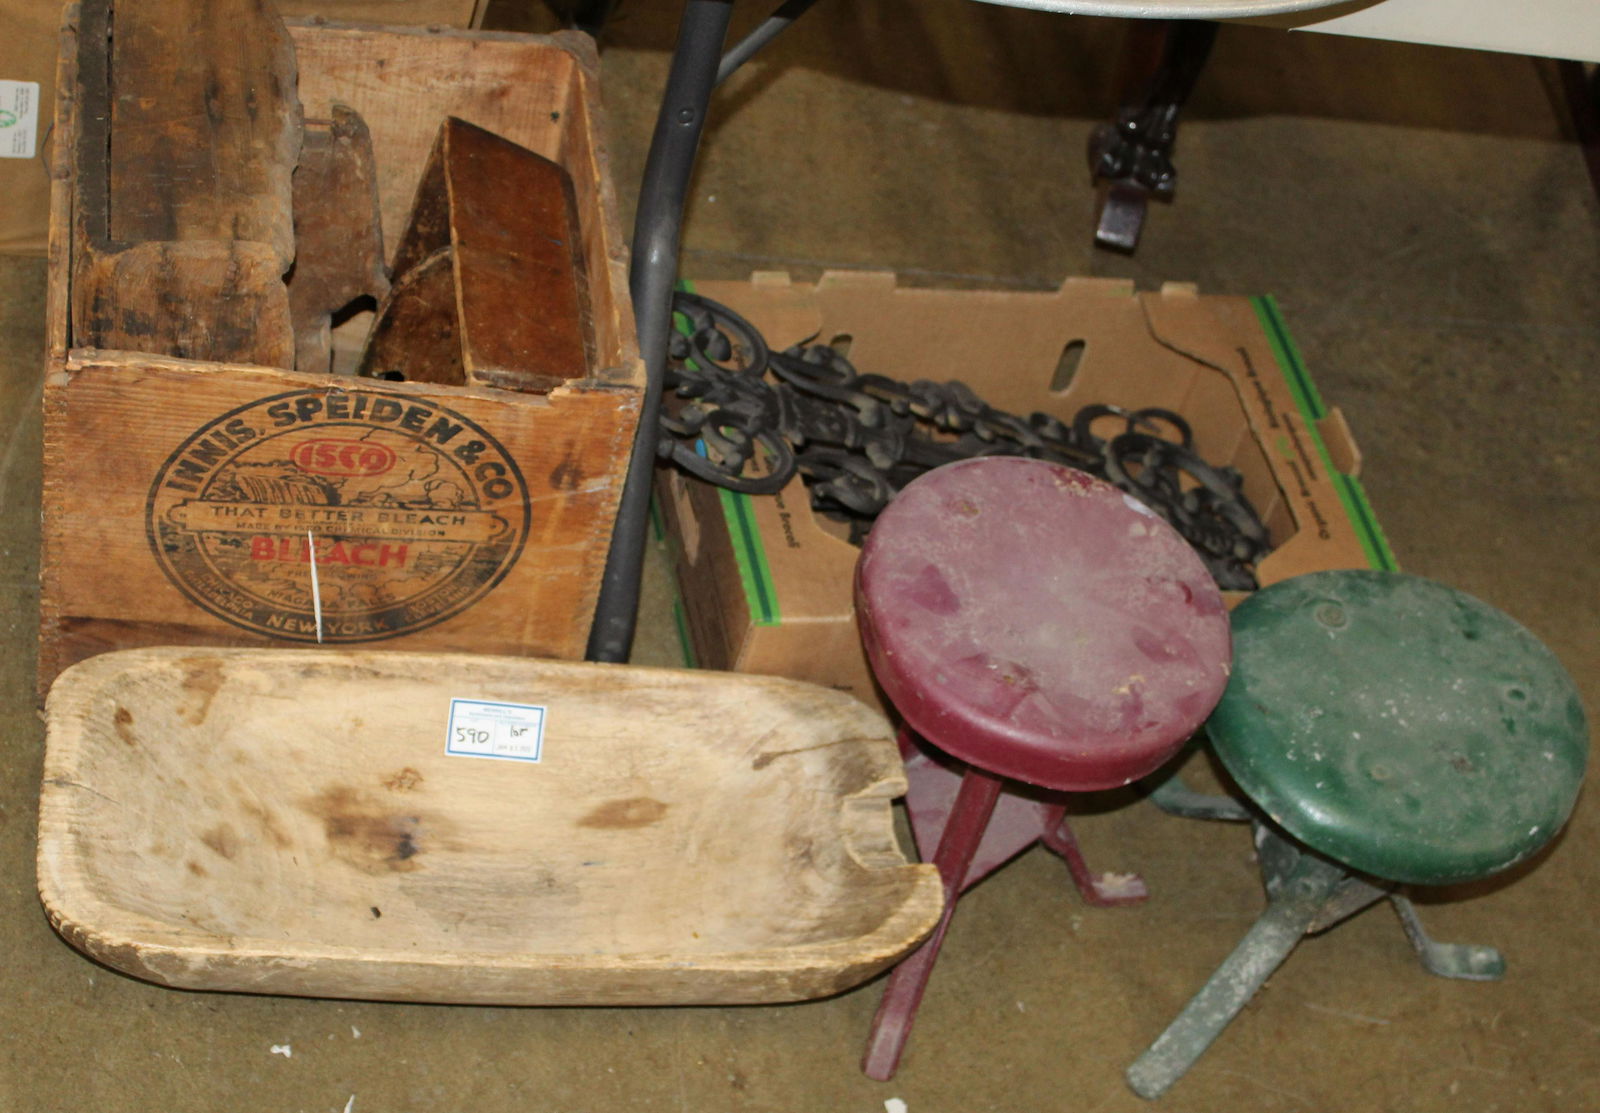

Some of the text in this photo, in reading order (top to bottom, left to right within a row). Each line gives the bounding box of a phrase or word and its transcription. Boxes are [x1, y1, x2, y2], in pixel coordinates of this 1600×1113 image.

[267, 395, 464, 445] SPEIDEN
[300, 444, 388, 471] ISCO
[210, 504, 466, 526] THAT BETTER BLEACH
[236, 522, 268, 531] MADE
[326, 525, 389, 535] CHEMICAL
[391, 527, 446, 537] DIVISION
[251, 535, 409, 569] BLEACH
[266, 614, 390, 635] NEW YORK
[456, 727, 490, 744] 590
